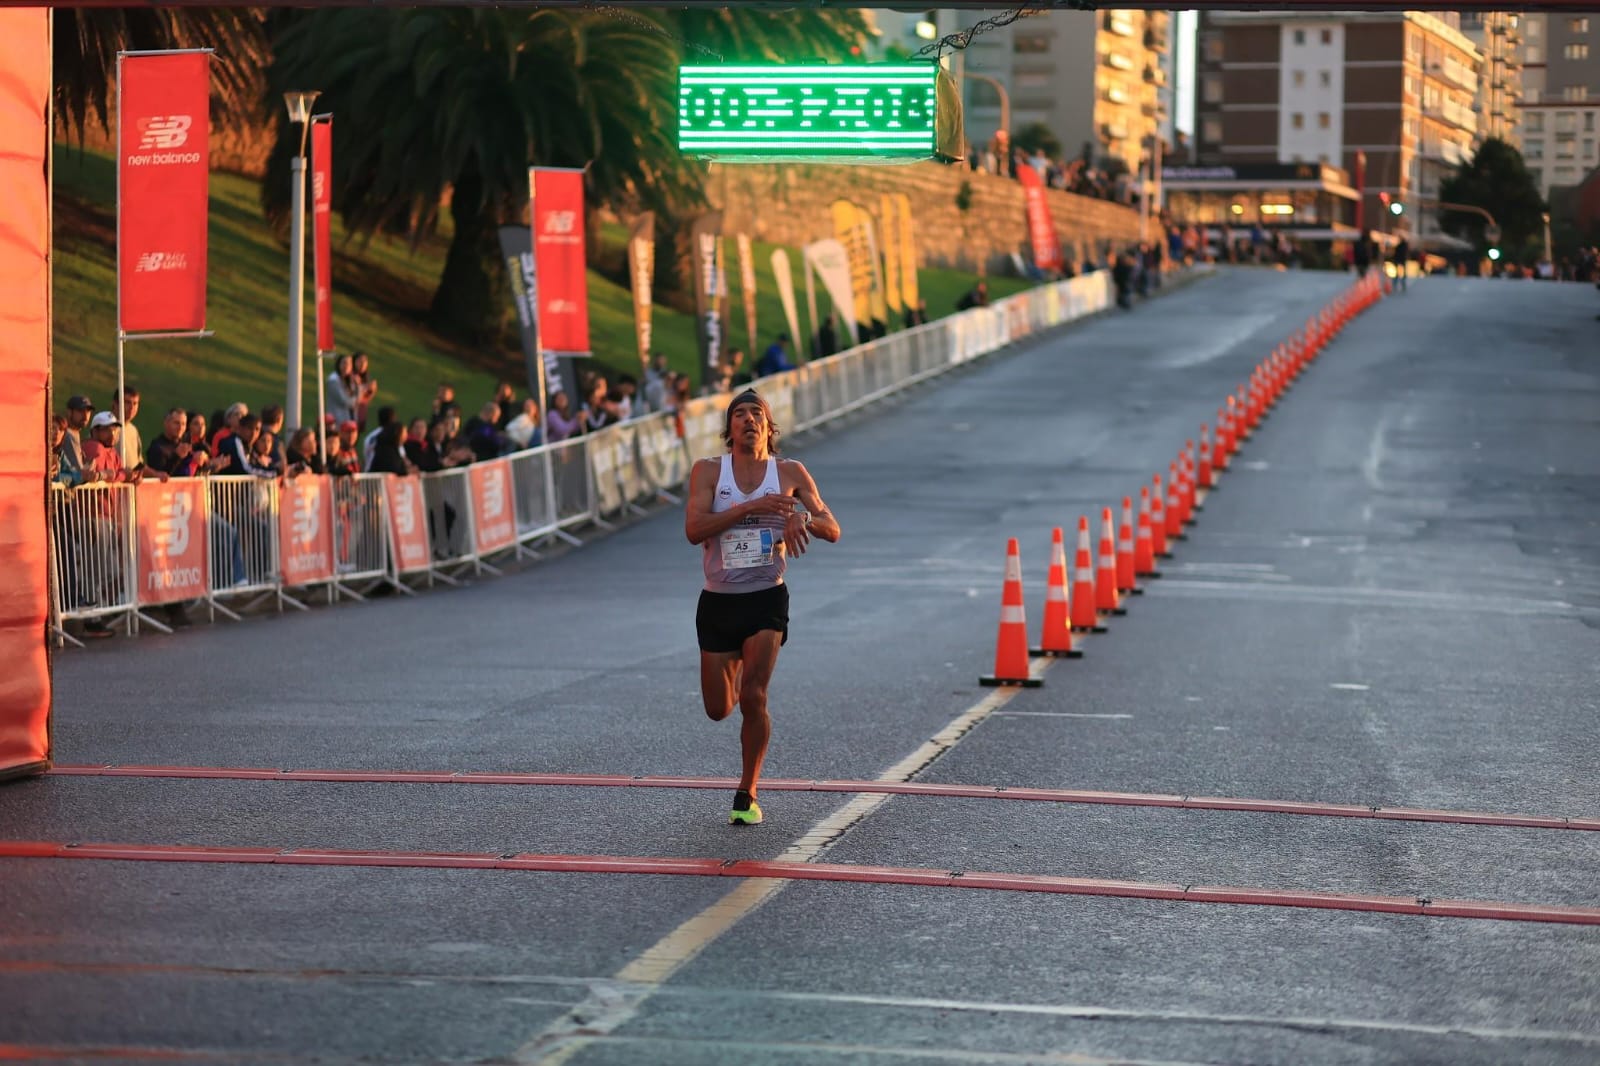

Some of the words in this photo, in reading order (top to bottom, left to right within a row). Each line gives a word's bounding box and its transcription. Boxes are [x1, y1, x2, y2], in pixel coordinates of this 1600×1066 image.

[127, 155, 151, 166] new
[152, 152, 200, 165] balance
[735, 542, 749, 551] A5
